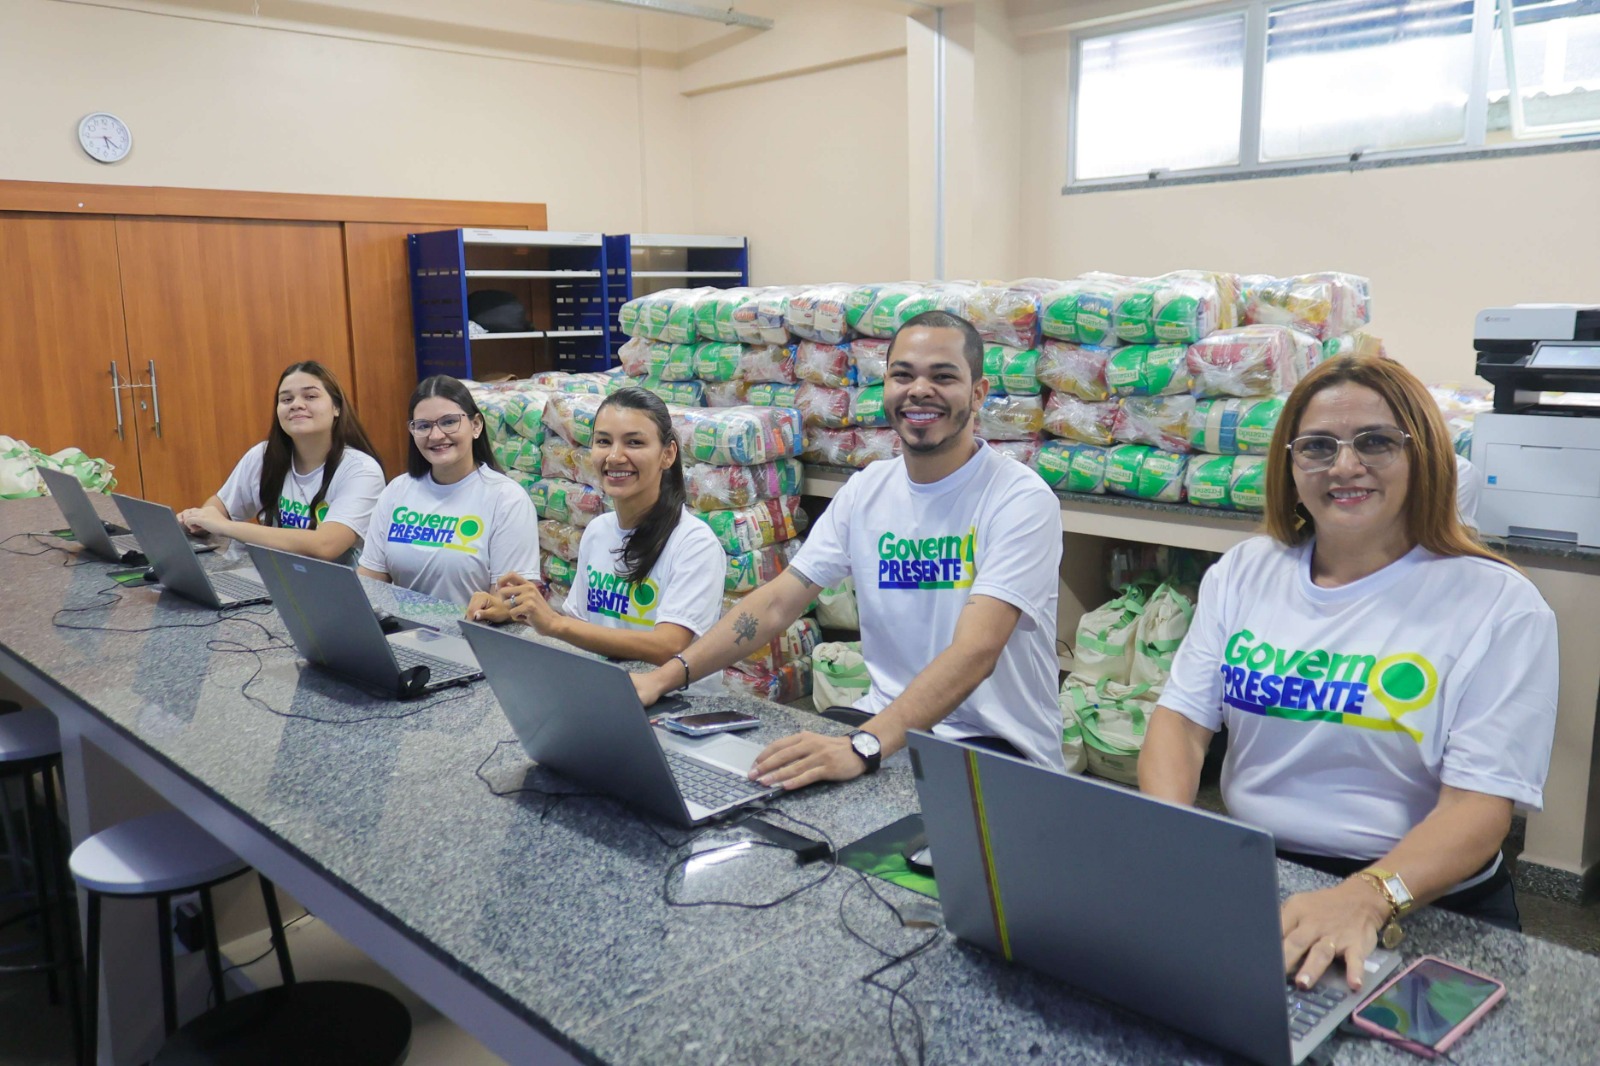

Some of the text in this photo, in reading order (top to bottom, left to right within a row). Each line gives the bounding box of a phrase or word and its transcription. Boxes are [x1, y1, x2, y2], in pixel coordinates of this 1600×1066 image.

[388, 523, 456, 543] PRESENTE
[879, 558, 962, 582] PRESENTE
[1220, 664, 1368, 715] PRESENTE
